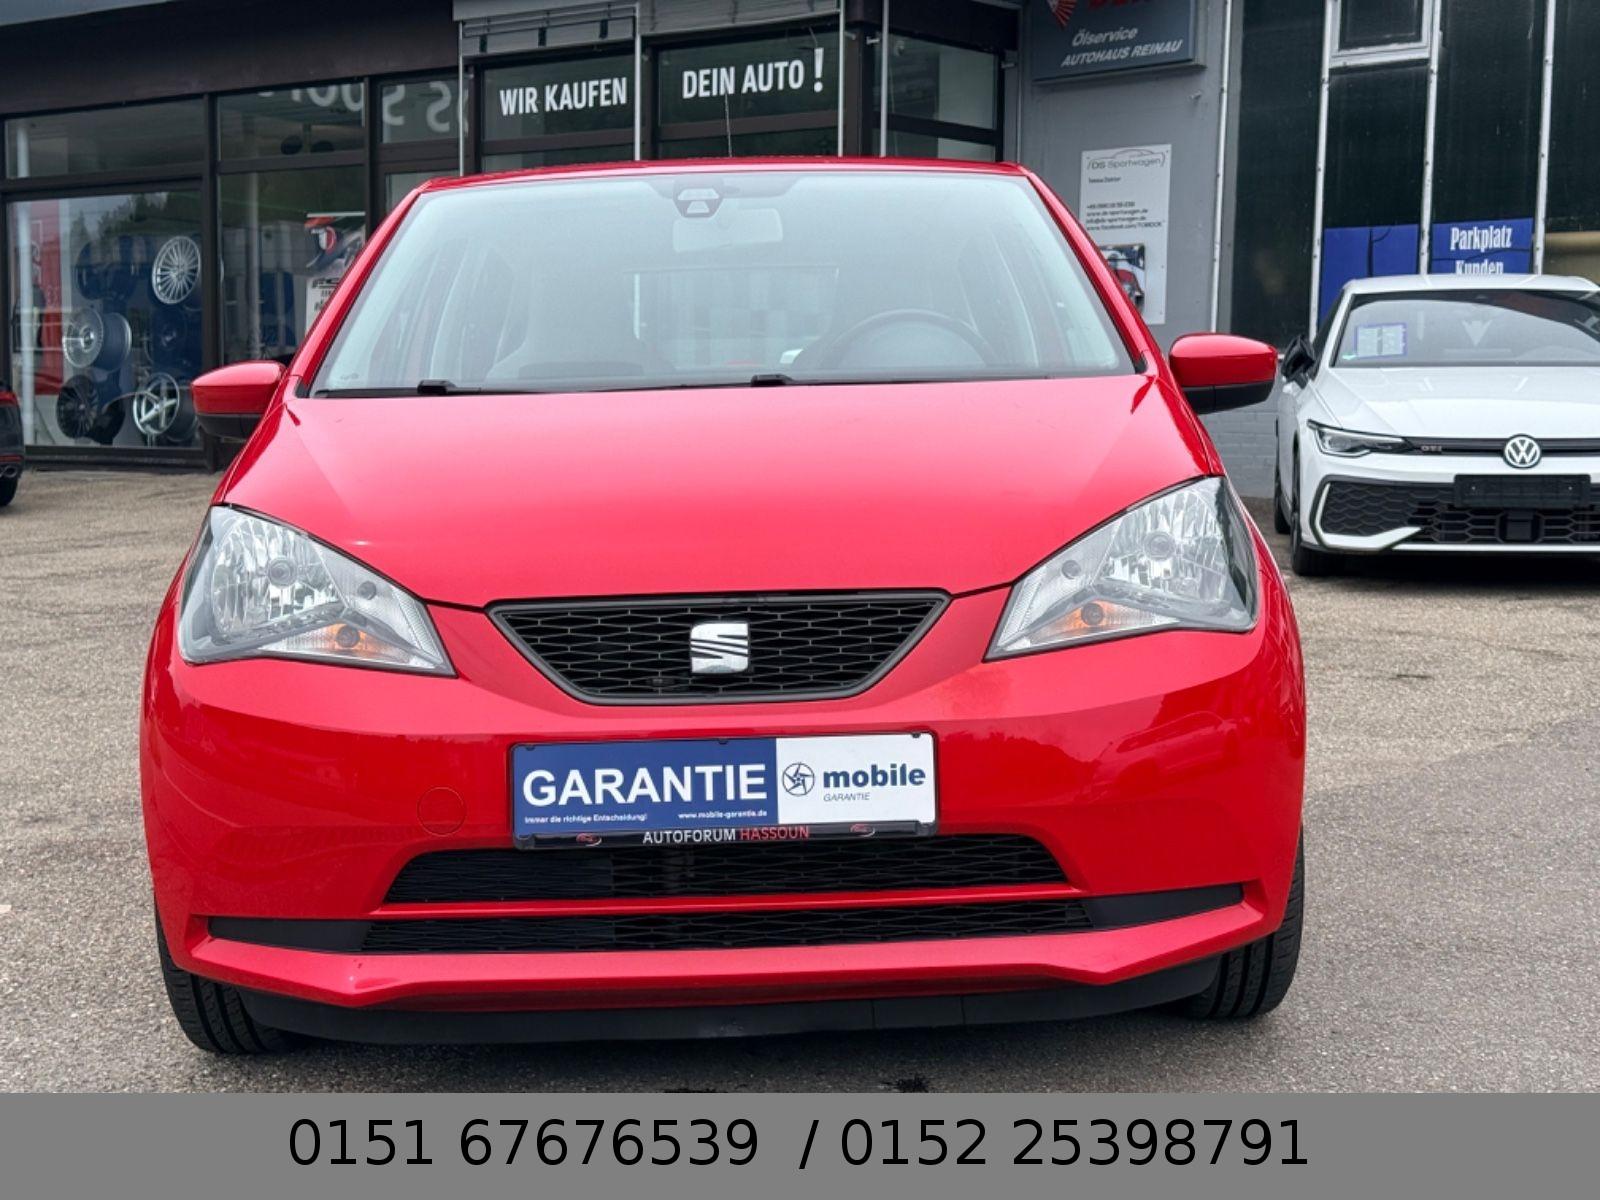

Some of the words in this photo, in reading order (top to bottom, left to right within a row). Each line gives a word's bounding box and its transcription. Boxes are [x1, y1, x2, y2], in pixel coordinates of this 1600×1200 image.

[1072, 26, 1138, 47] Ölservice
[1061, 47, 1131, 67] AUTOHAUS
[1131, 39, 1183, 57] REINAU
[682, 66, 736, 99] DEIN
[742, 59, 805, 94] AUTO
[500, 87, 538, 116] WIR
[545, 76, 628, 112] KAUFEN
[1450, 224, 1513, 252] Parkplatz
[1455, 259, 1504, 275] Kunden
[522, 763, 768, 806] GARANTIE
[823, 763, 926, 788] mobile
[823, 791, 871, 802] GARANTIE
[524, 816, 550, 824] Immer
[550, 815, 561, 823] die
[563, 814, 592, 825] richtige
[678, 808, 768, 820] www.mobile-garantie.de
[642, 828, 736, 845] AUTOFORUM
[740, 825, 810, 842] HASSOUN
